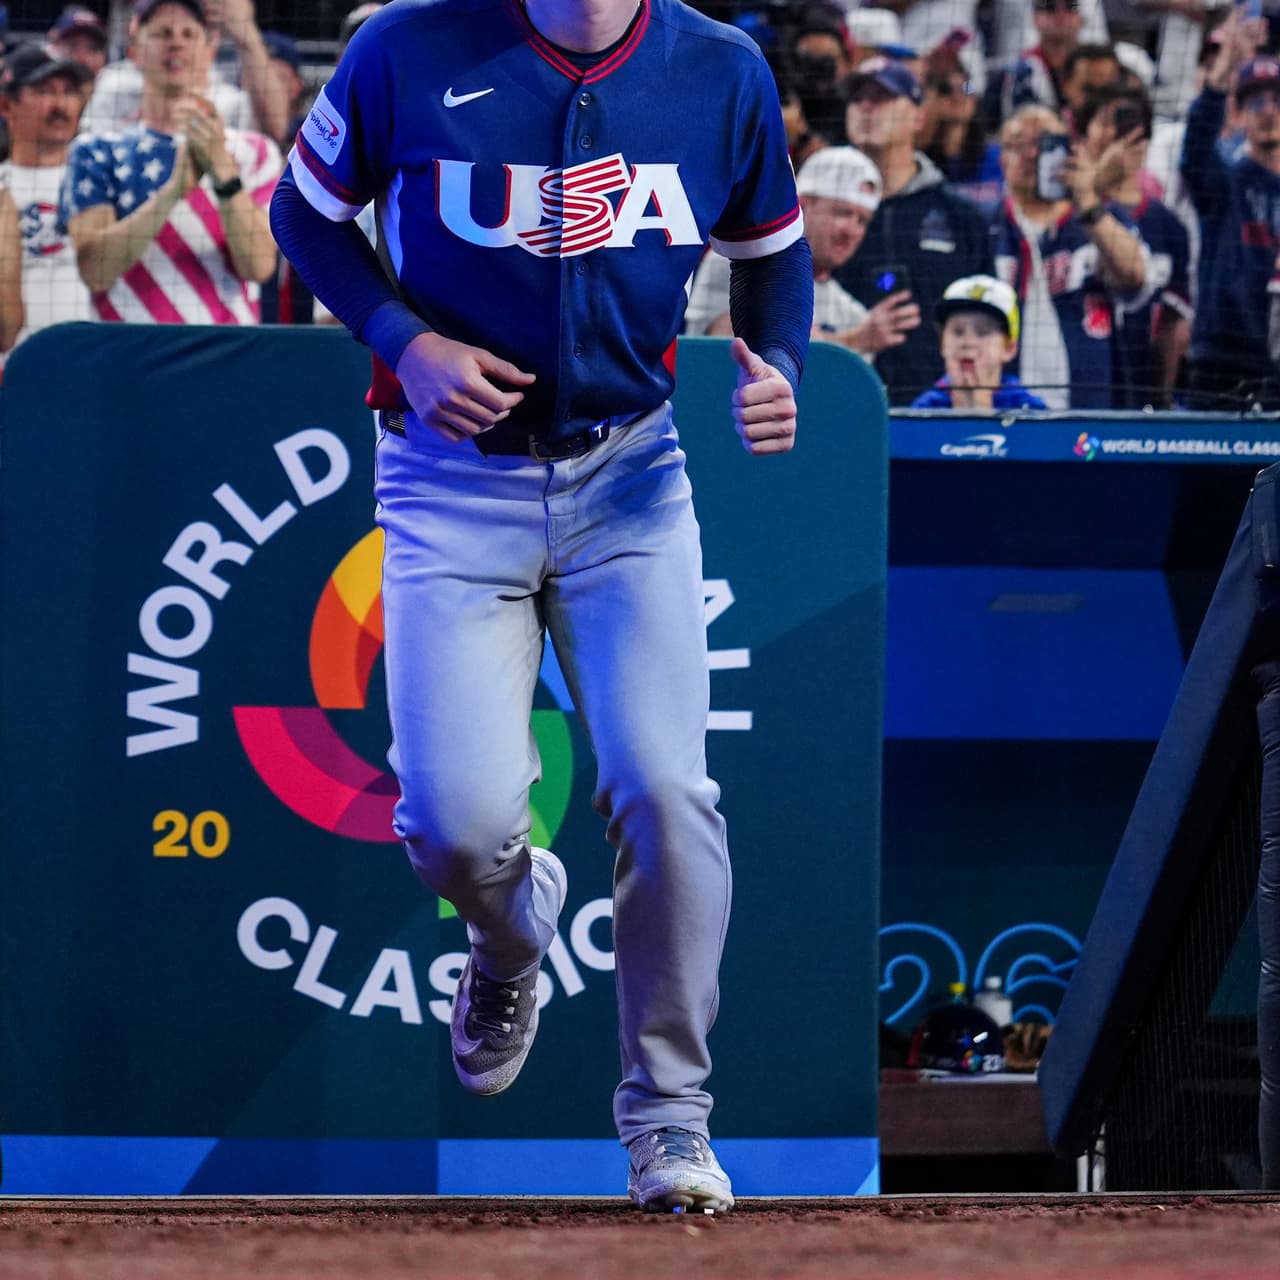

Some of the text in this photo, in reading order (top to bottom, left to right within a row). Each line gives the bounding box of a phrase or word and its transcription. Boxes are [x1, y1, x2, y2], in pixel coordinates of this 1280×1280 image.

[433, 153, 703, 259] USA
[1102, 440, 1156, 454] WORLD
[1158, 440, 1231, 455] BASEBALL
[125, 427, 352, 758] WORLD
[152, 809, 231, 858] 20
